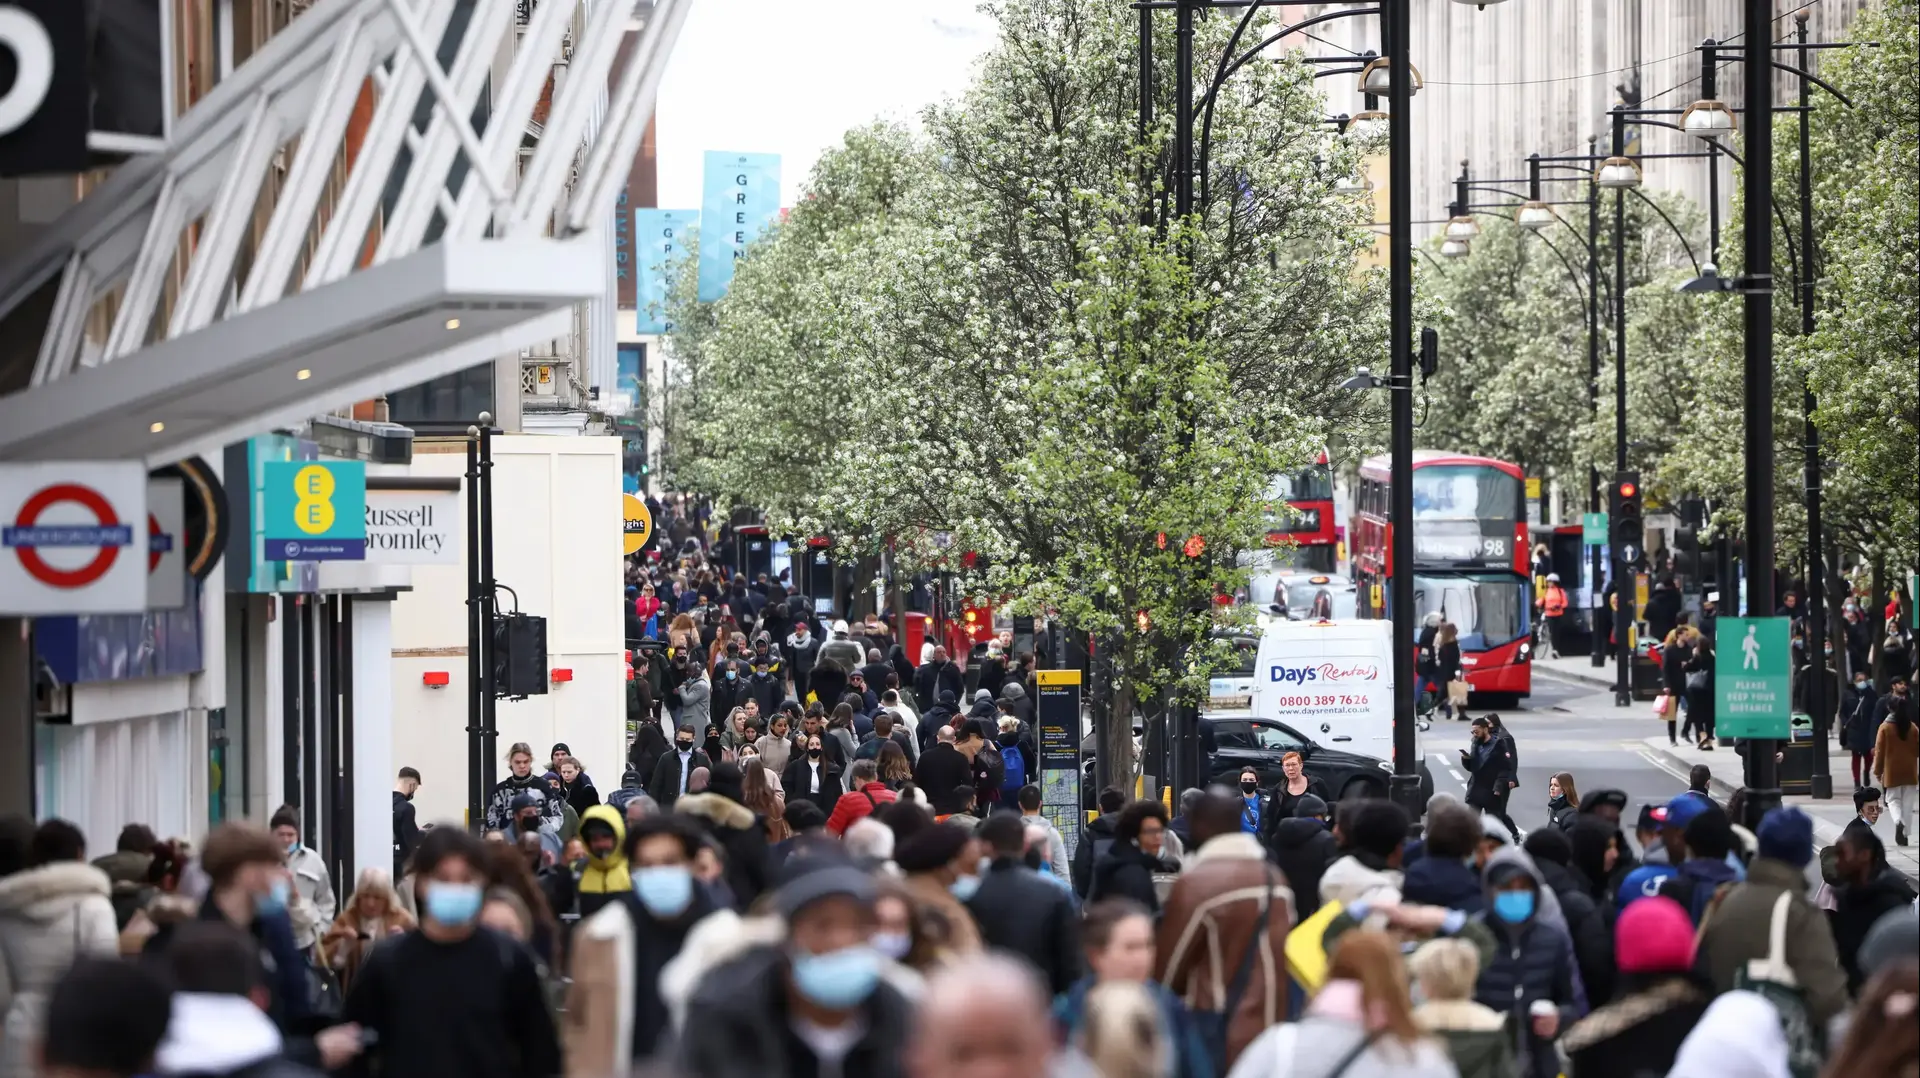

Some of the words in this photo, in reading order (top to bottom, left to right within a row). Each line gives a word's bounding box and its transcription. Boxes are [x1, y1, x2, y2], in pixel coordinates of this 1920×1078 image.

[1483, 539, 1505, 556] 98
[1270, 665, 1317, 686] Day's
[1317, 663, 1371, 681] Rental
[1735, 681, 1768, 690] PLEASE
[1280, 696, 1311, 707] 0800
[1314, 695, 1336, 706] 389
[1339, 695, 1369, 705] 7626
[1278, 706, 1371, 716] www.daysrental.co.uk
